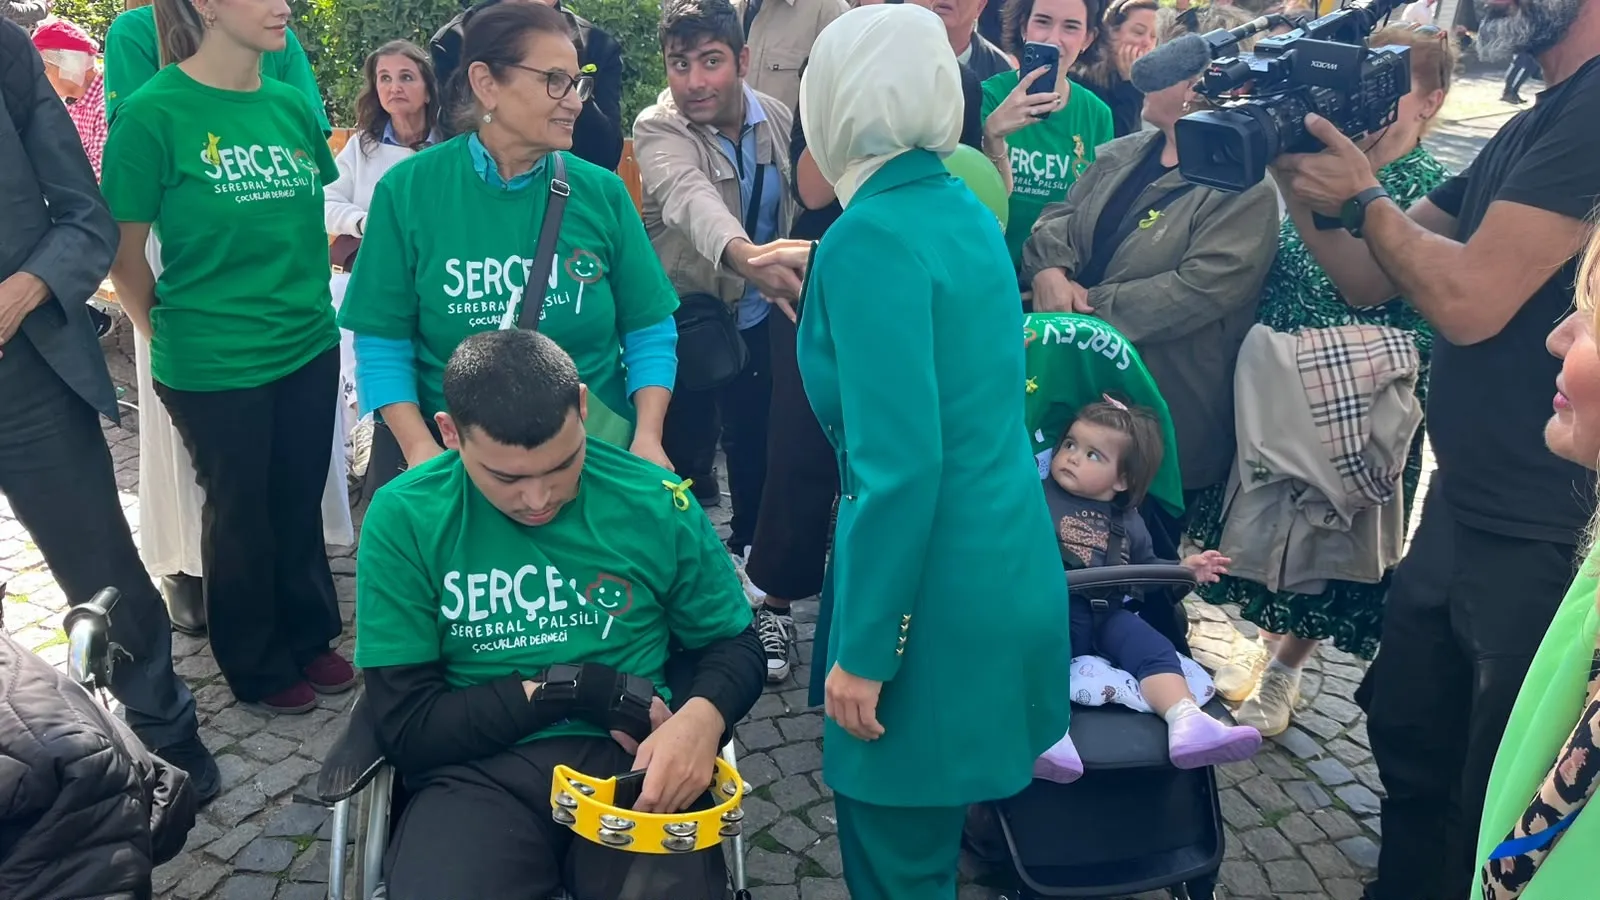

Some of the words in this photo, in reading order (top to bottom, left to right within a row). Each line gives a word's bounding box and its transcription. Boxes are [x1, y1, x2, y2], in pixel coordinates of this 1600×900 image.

[200, 144, 299, 183] SERÇEV
[1010, 147, 1070, 182] ERÇEV
[214, 181, 268, 194] SEREBRAL
[447, 300, 511, 315] SEREBRA
[451, 619, 526, 638] SEREBRAL
[538, 610, 599, 630] PALSİLİ
[472, 635, 527, 653] ÇOCUKLAR
[529, 629, 568, 646] DERNEĞİ
